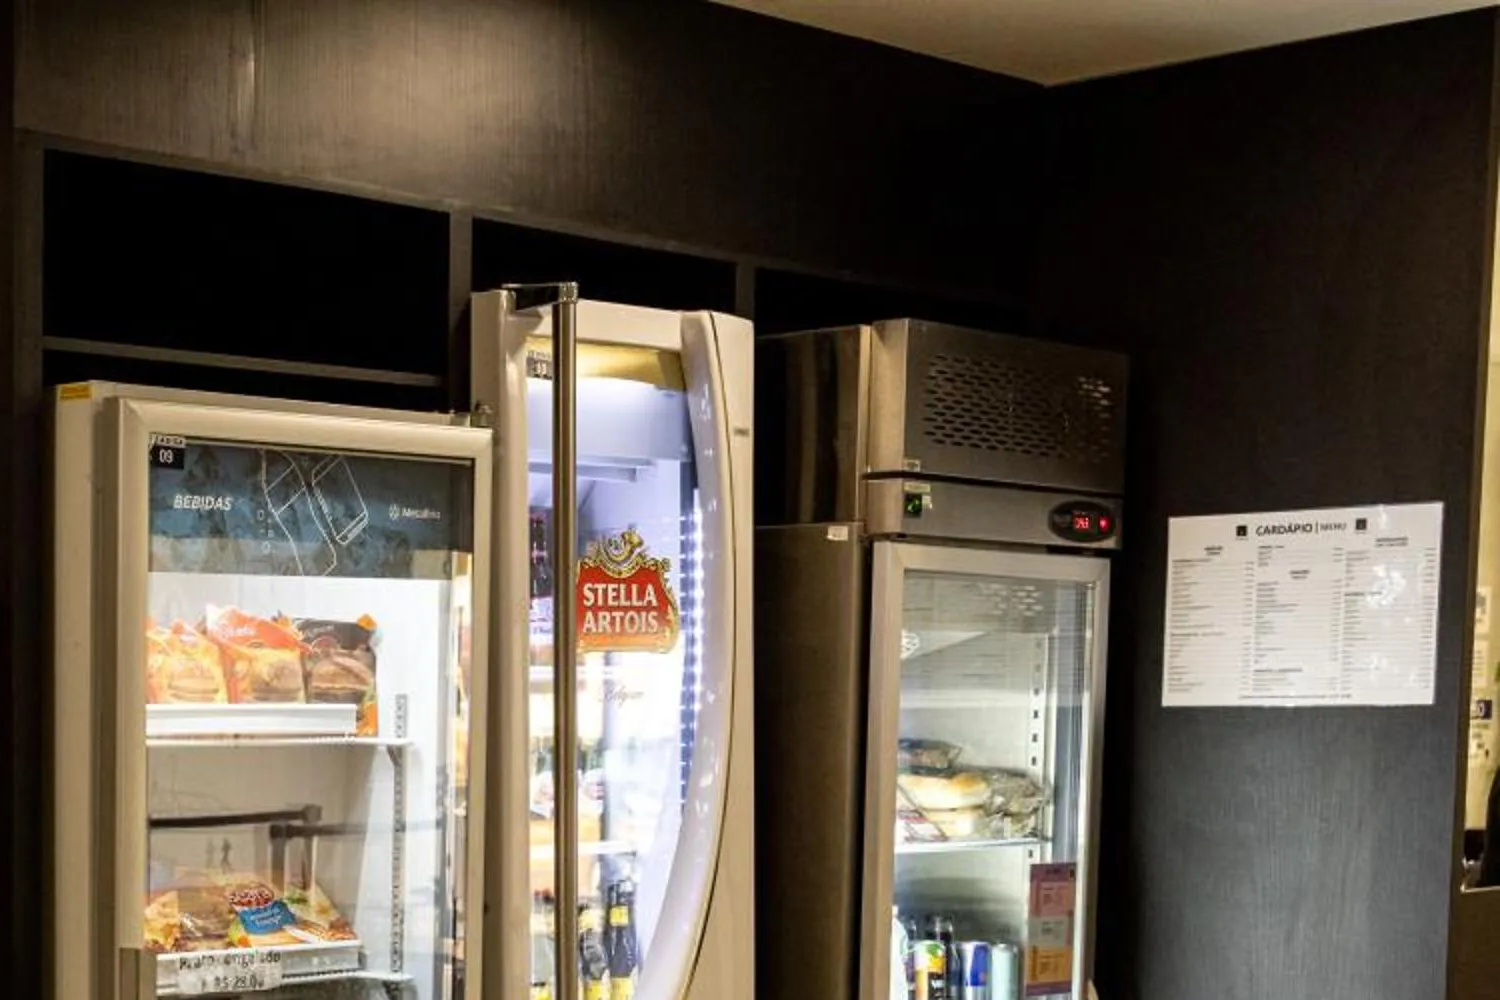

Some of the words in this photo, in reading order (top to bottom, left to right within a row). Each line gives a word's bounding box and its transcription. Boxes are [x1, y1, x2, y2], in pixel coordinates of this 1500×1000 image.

[173, 493, 233, 512] BEBIDAS
[583, 583, 658, 608] STELLA
[582, 610, 660, 634] ARTOIS
